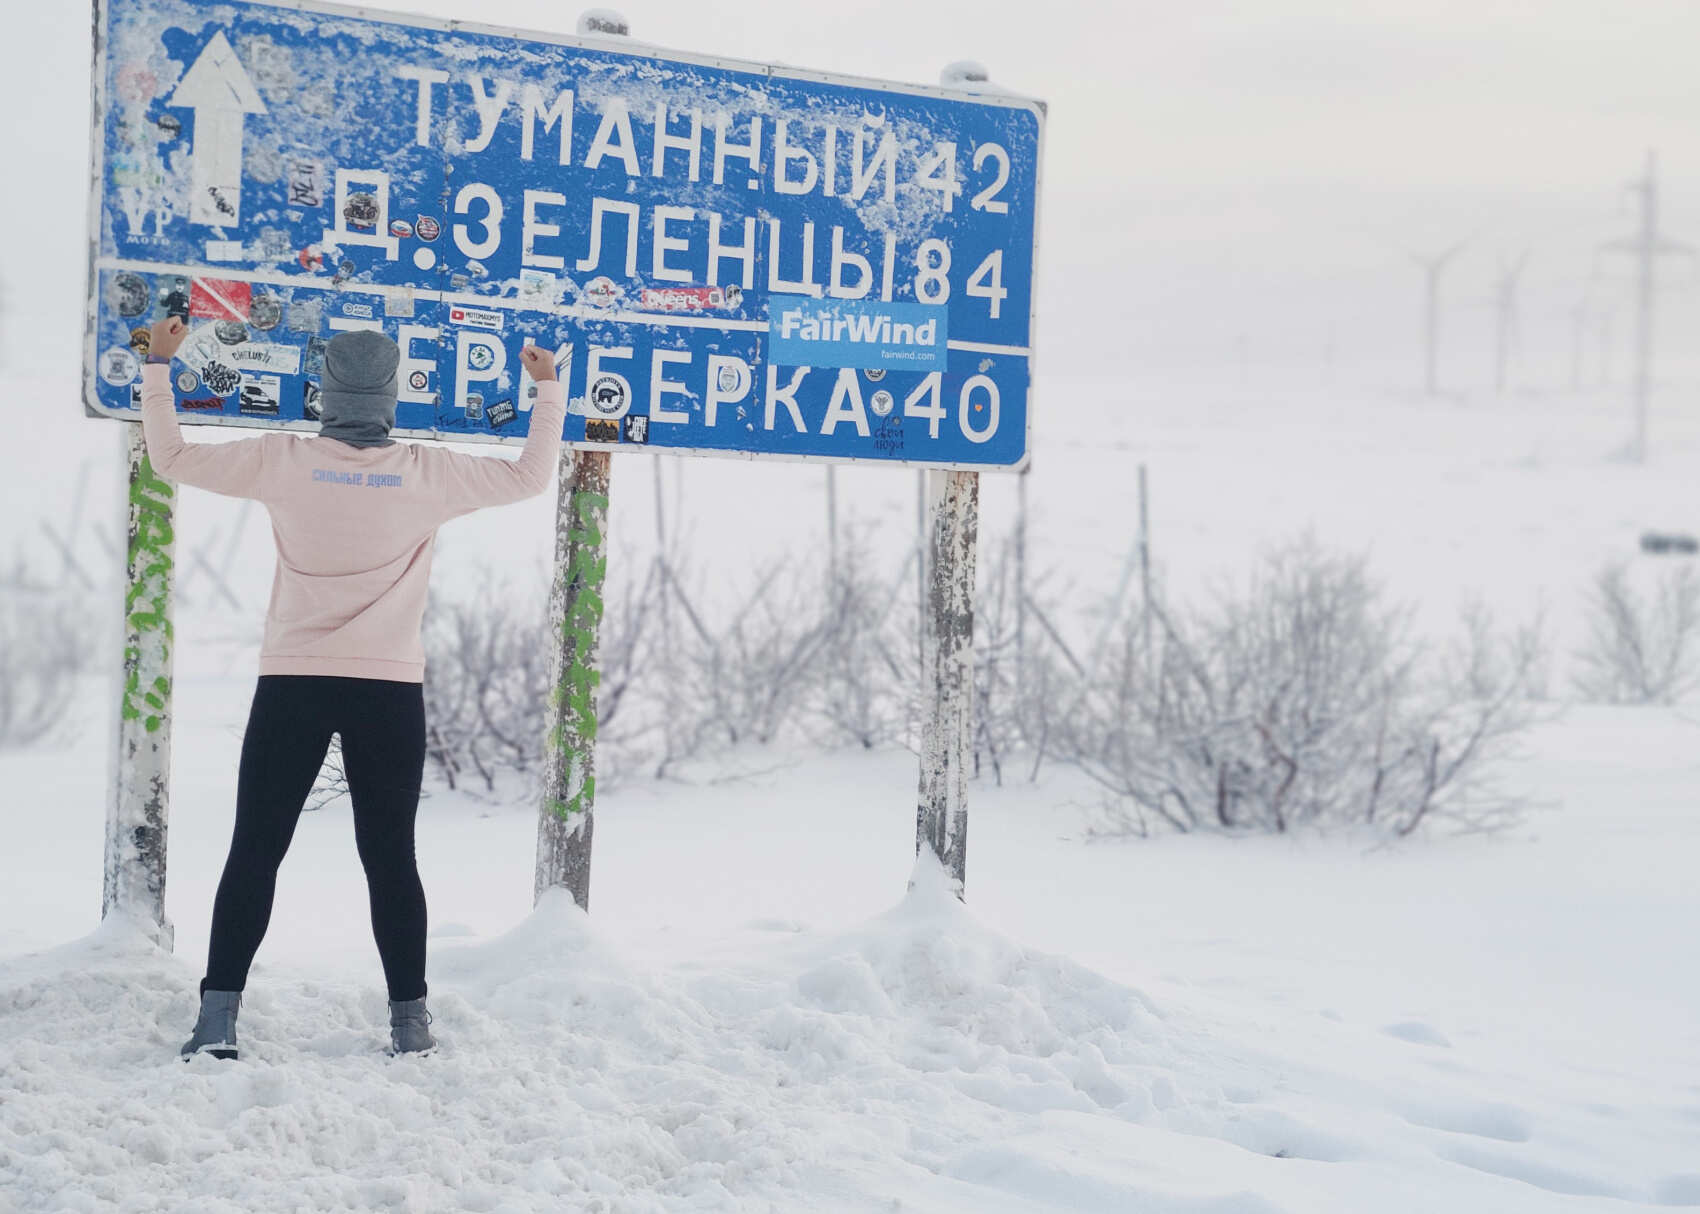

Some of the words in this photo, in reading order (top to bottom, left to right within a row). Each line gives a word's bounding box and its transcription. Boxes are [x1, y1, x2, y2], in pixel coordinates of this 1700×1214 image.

[398, 65, 897, 204] ТУМАННЫЙ
[913, 141, 1009, 215] 42
[914, 238, 1008, 319] 84
[780, 310, 937, 346] FairWind
[881, 350, 935, 362] fairwind.com
[329, 317, 872, 438] ЕРИБЕРКА
[904, 370, 1001, 444] 40
